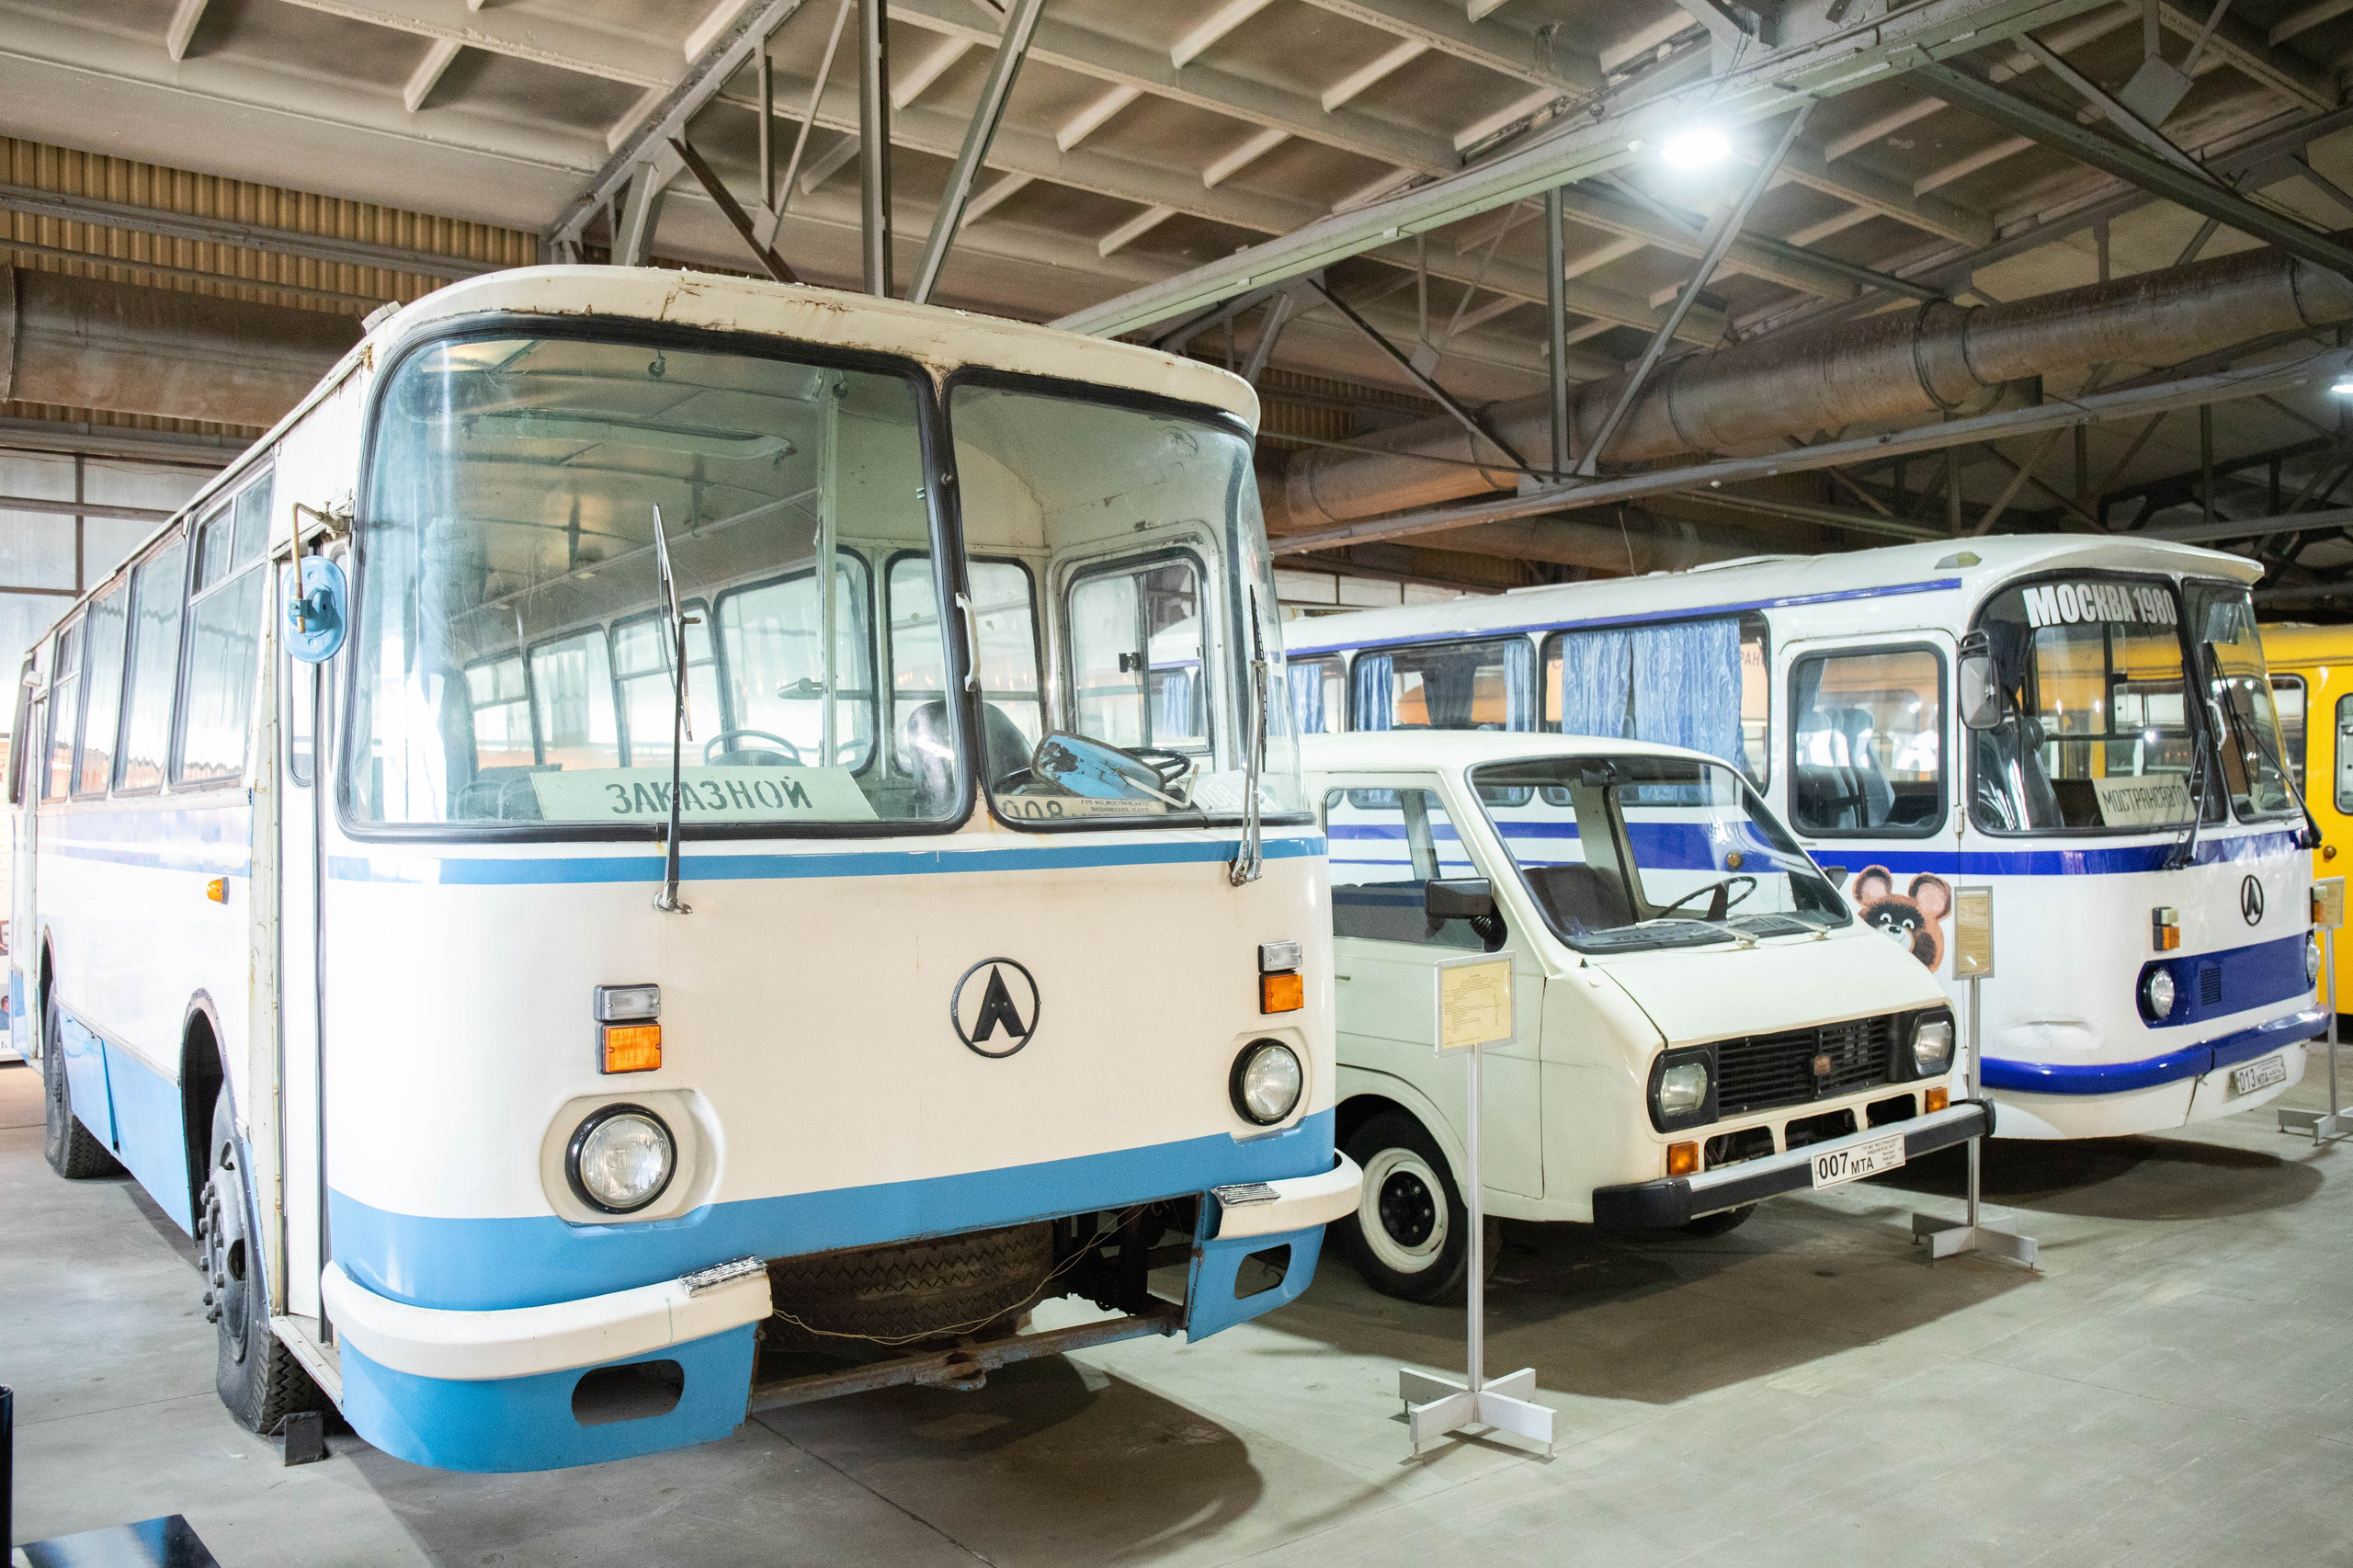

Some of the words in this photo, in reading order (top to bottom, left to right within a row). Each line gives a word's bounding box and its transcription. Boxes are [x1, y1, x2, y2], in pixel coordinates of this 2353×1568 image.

[2022, 584, 2137, 628] МОСКВА
[2132, 587, 2177, 626] 1980
[605, 776, 813, 814] ЗАКАЗНОЙ
[2101, 785, 2188, 812] МОСТРАНСАВТО
[2239, 1068, 2256, 1091] 013
[1819, 1152, 1848, 1179] 007
[1851, 1156, 1874, 1175] МТА
